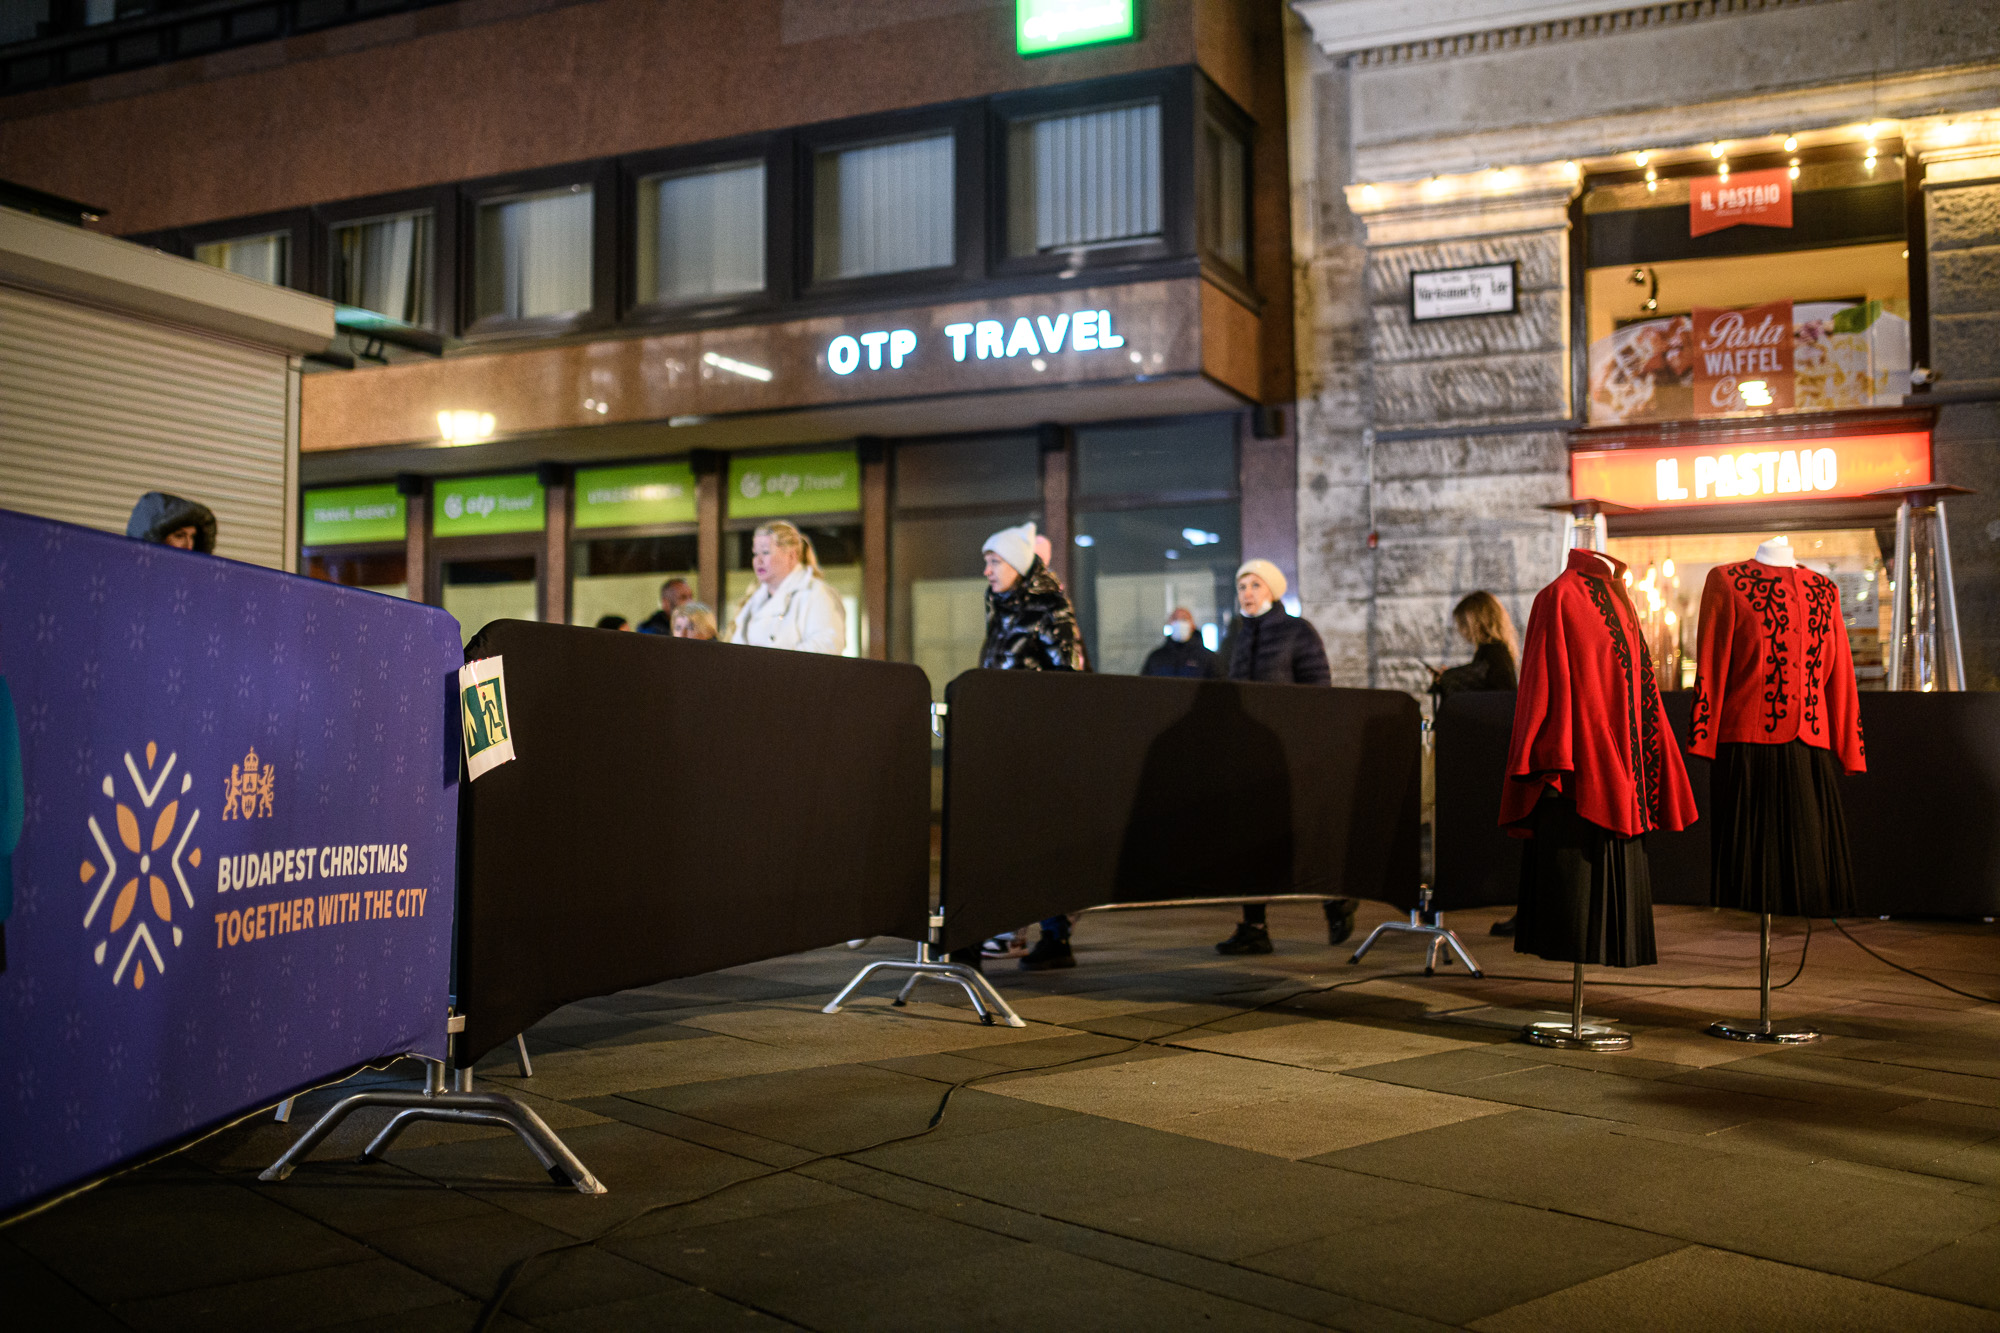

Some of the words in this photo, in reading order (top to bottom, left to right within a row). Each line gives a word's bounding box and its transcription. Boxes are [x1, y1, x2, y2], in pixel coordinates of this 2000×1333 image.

[1701, 191, 1715, 211] IL
[1718, 183, 1780, 209] PASTAIO
[827, 329, 917, 375] OTP
[944, 309, 1125, 362] TRAVEL
[1701, 312, 1785, 351] Pasta
[1704, 347, 1783, 376] WAFFEL
[765, 472, 801, 497] otp
[1656, 458, 1688, 501] IL
[1694, 448, 1838, 500] PASTAIO
[465, 493, 496, 519] otp
[217, 848, 317, 893] BUDAPEST
[319, 844, 408, 878] CHRISTMAS
[214, 897, 315, 949] TOGETHER
[318, 892, 361, 927] WITH
[364, 889, 393, 920] THE
[396, 888, 427, 918] CITY
